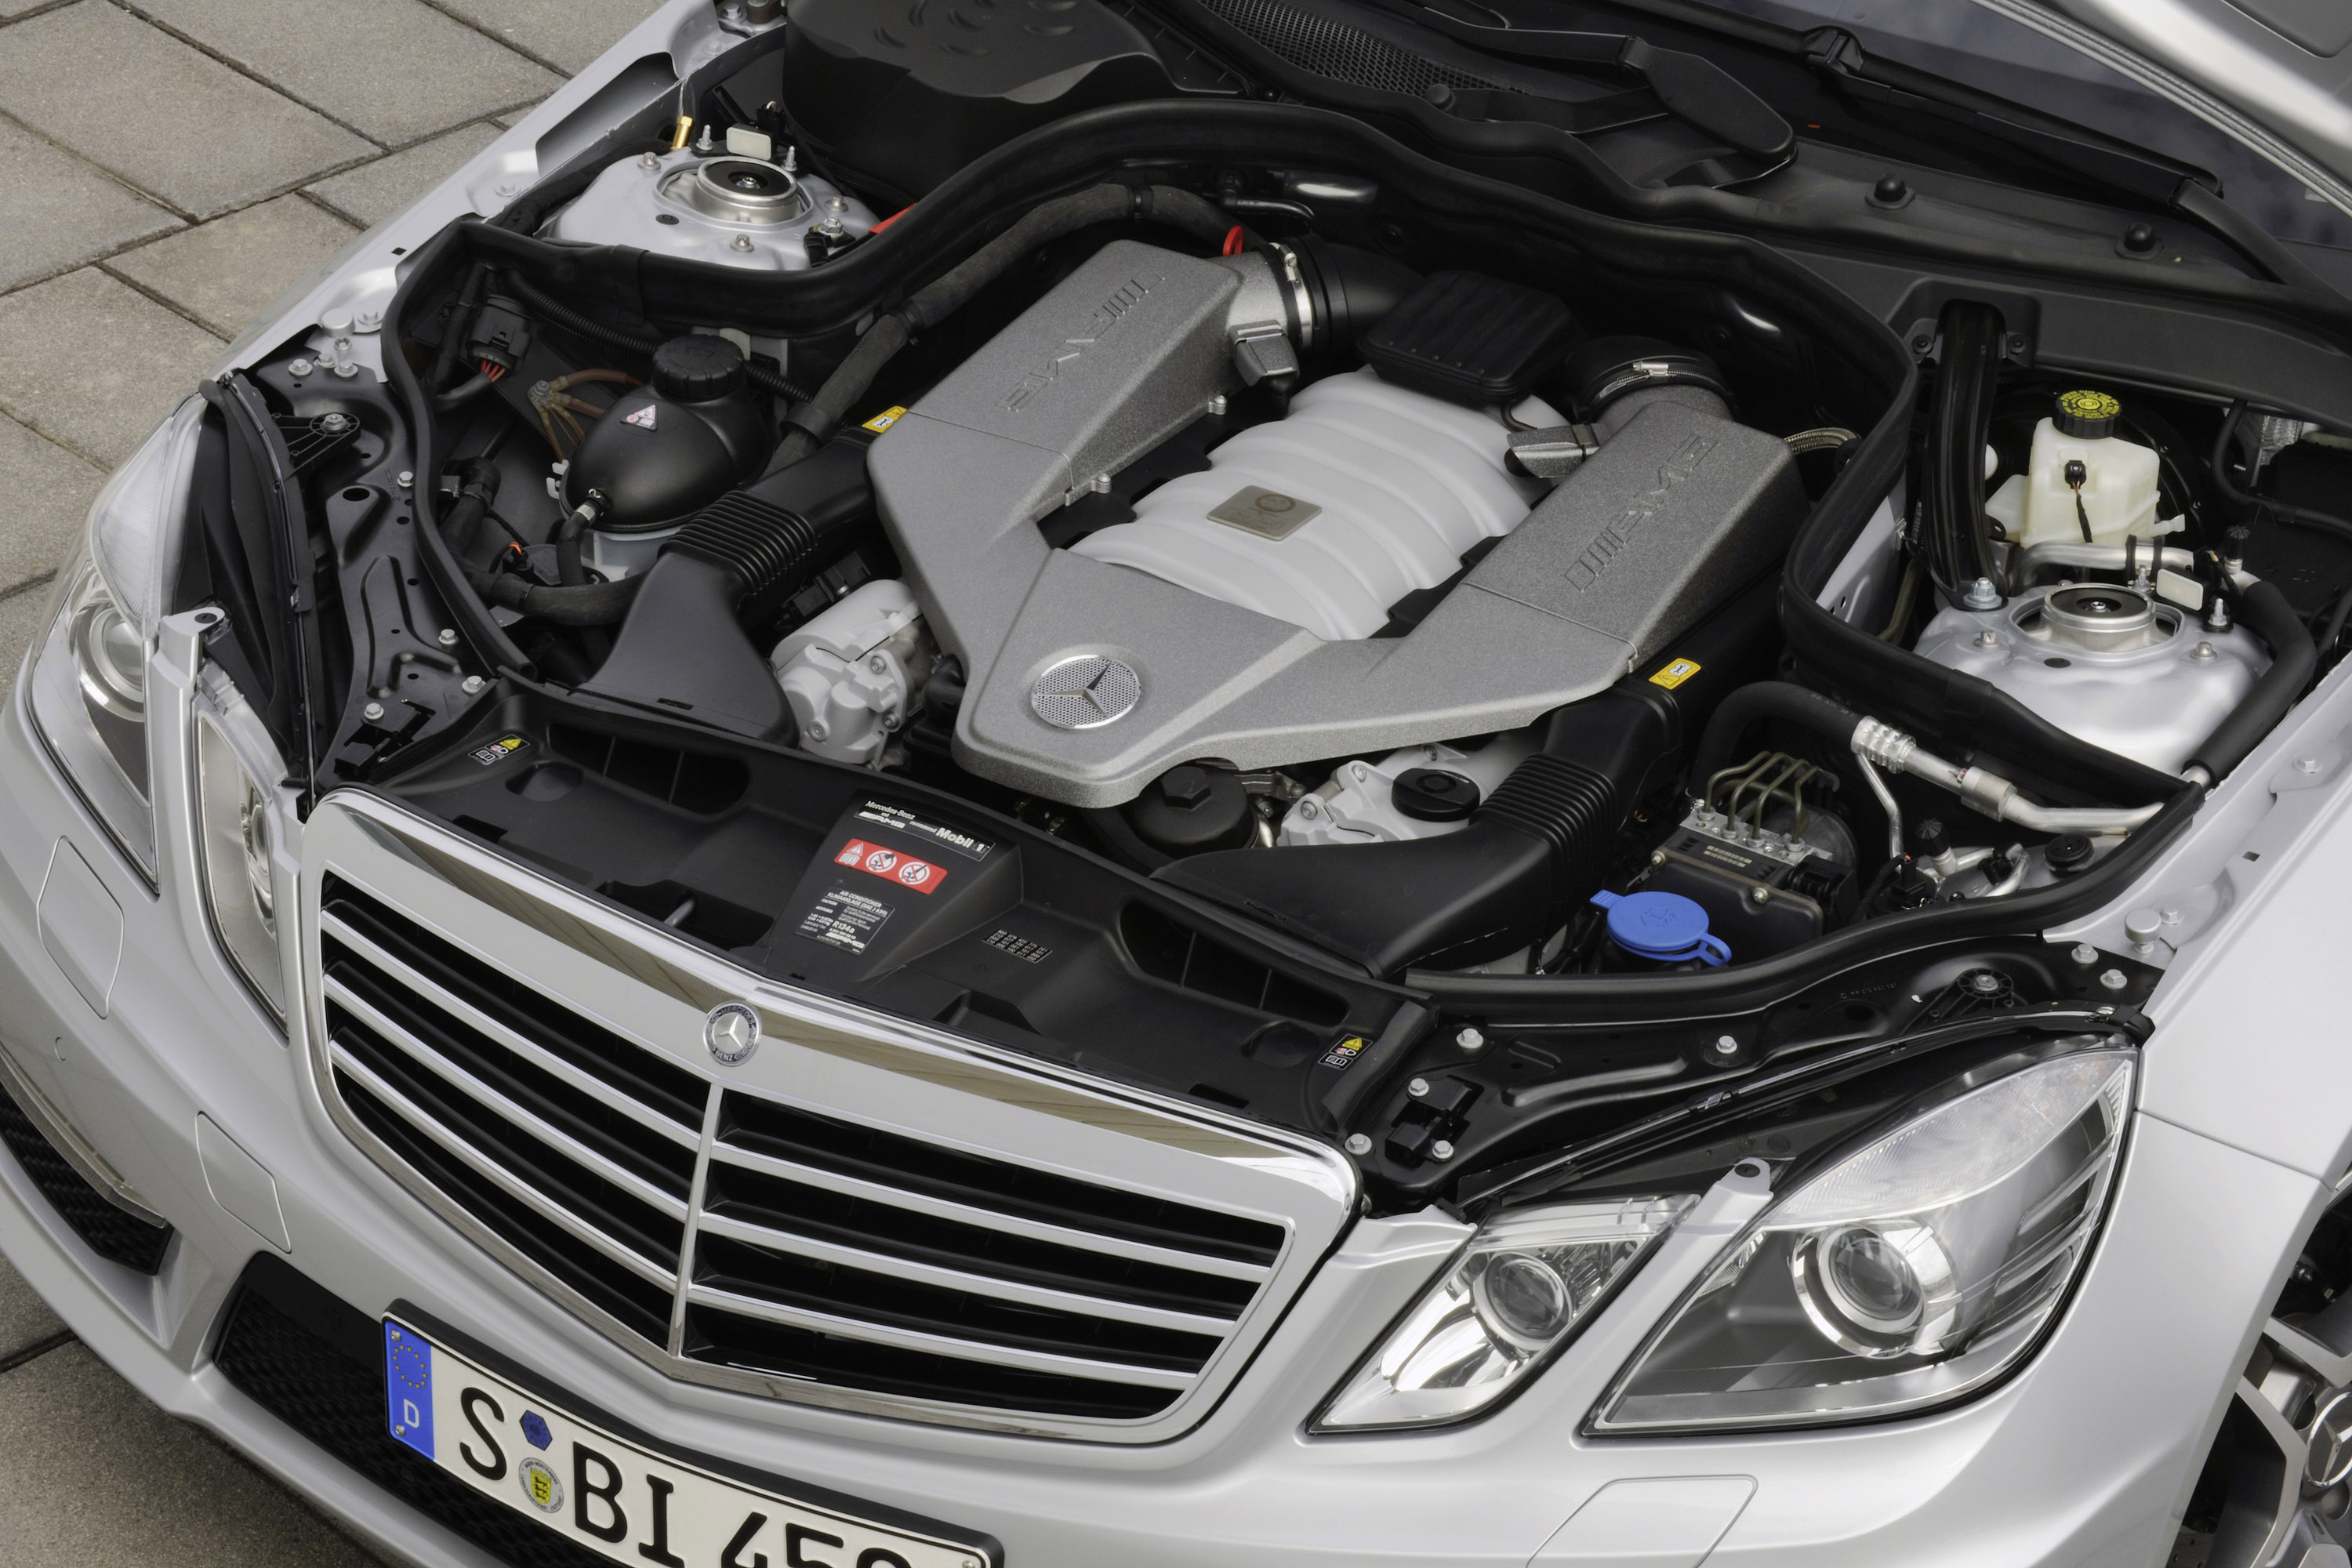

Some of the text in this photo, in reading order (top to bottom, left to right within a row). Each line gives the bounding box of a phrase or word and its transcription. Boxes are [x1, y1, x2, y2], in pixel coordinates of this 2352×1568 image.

[866, 800, 916, 820] Mercedes-Benz
[859, 811, 906, 829] AMG
[935, 828, 974, 848] Mobil
[827, 892, 862, 906] KLIMAANLAGE
[848, 894, 882, 908] CONDITIONER
[833, 920, 855, 934] R134a
[721, 1005, 756, 1025] MERCEDES
[715, 1050, 734, 1062] BENZ
[403, 1399, 419, 1428] D
[459, 1387, 507, 1481] S
[573, 1441, 685, 1568] BI
